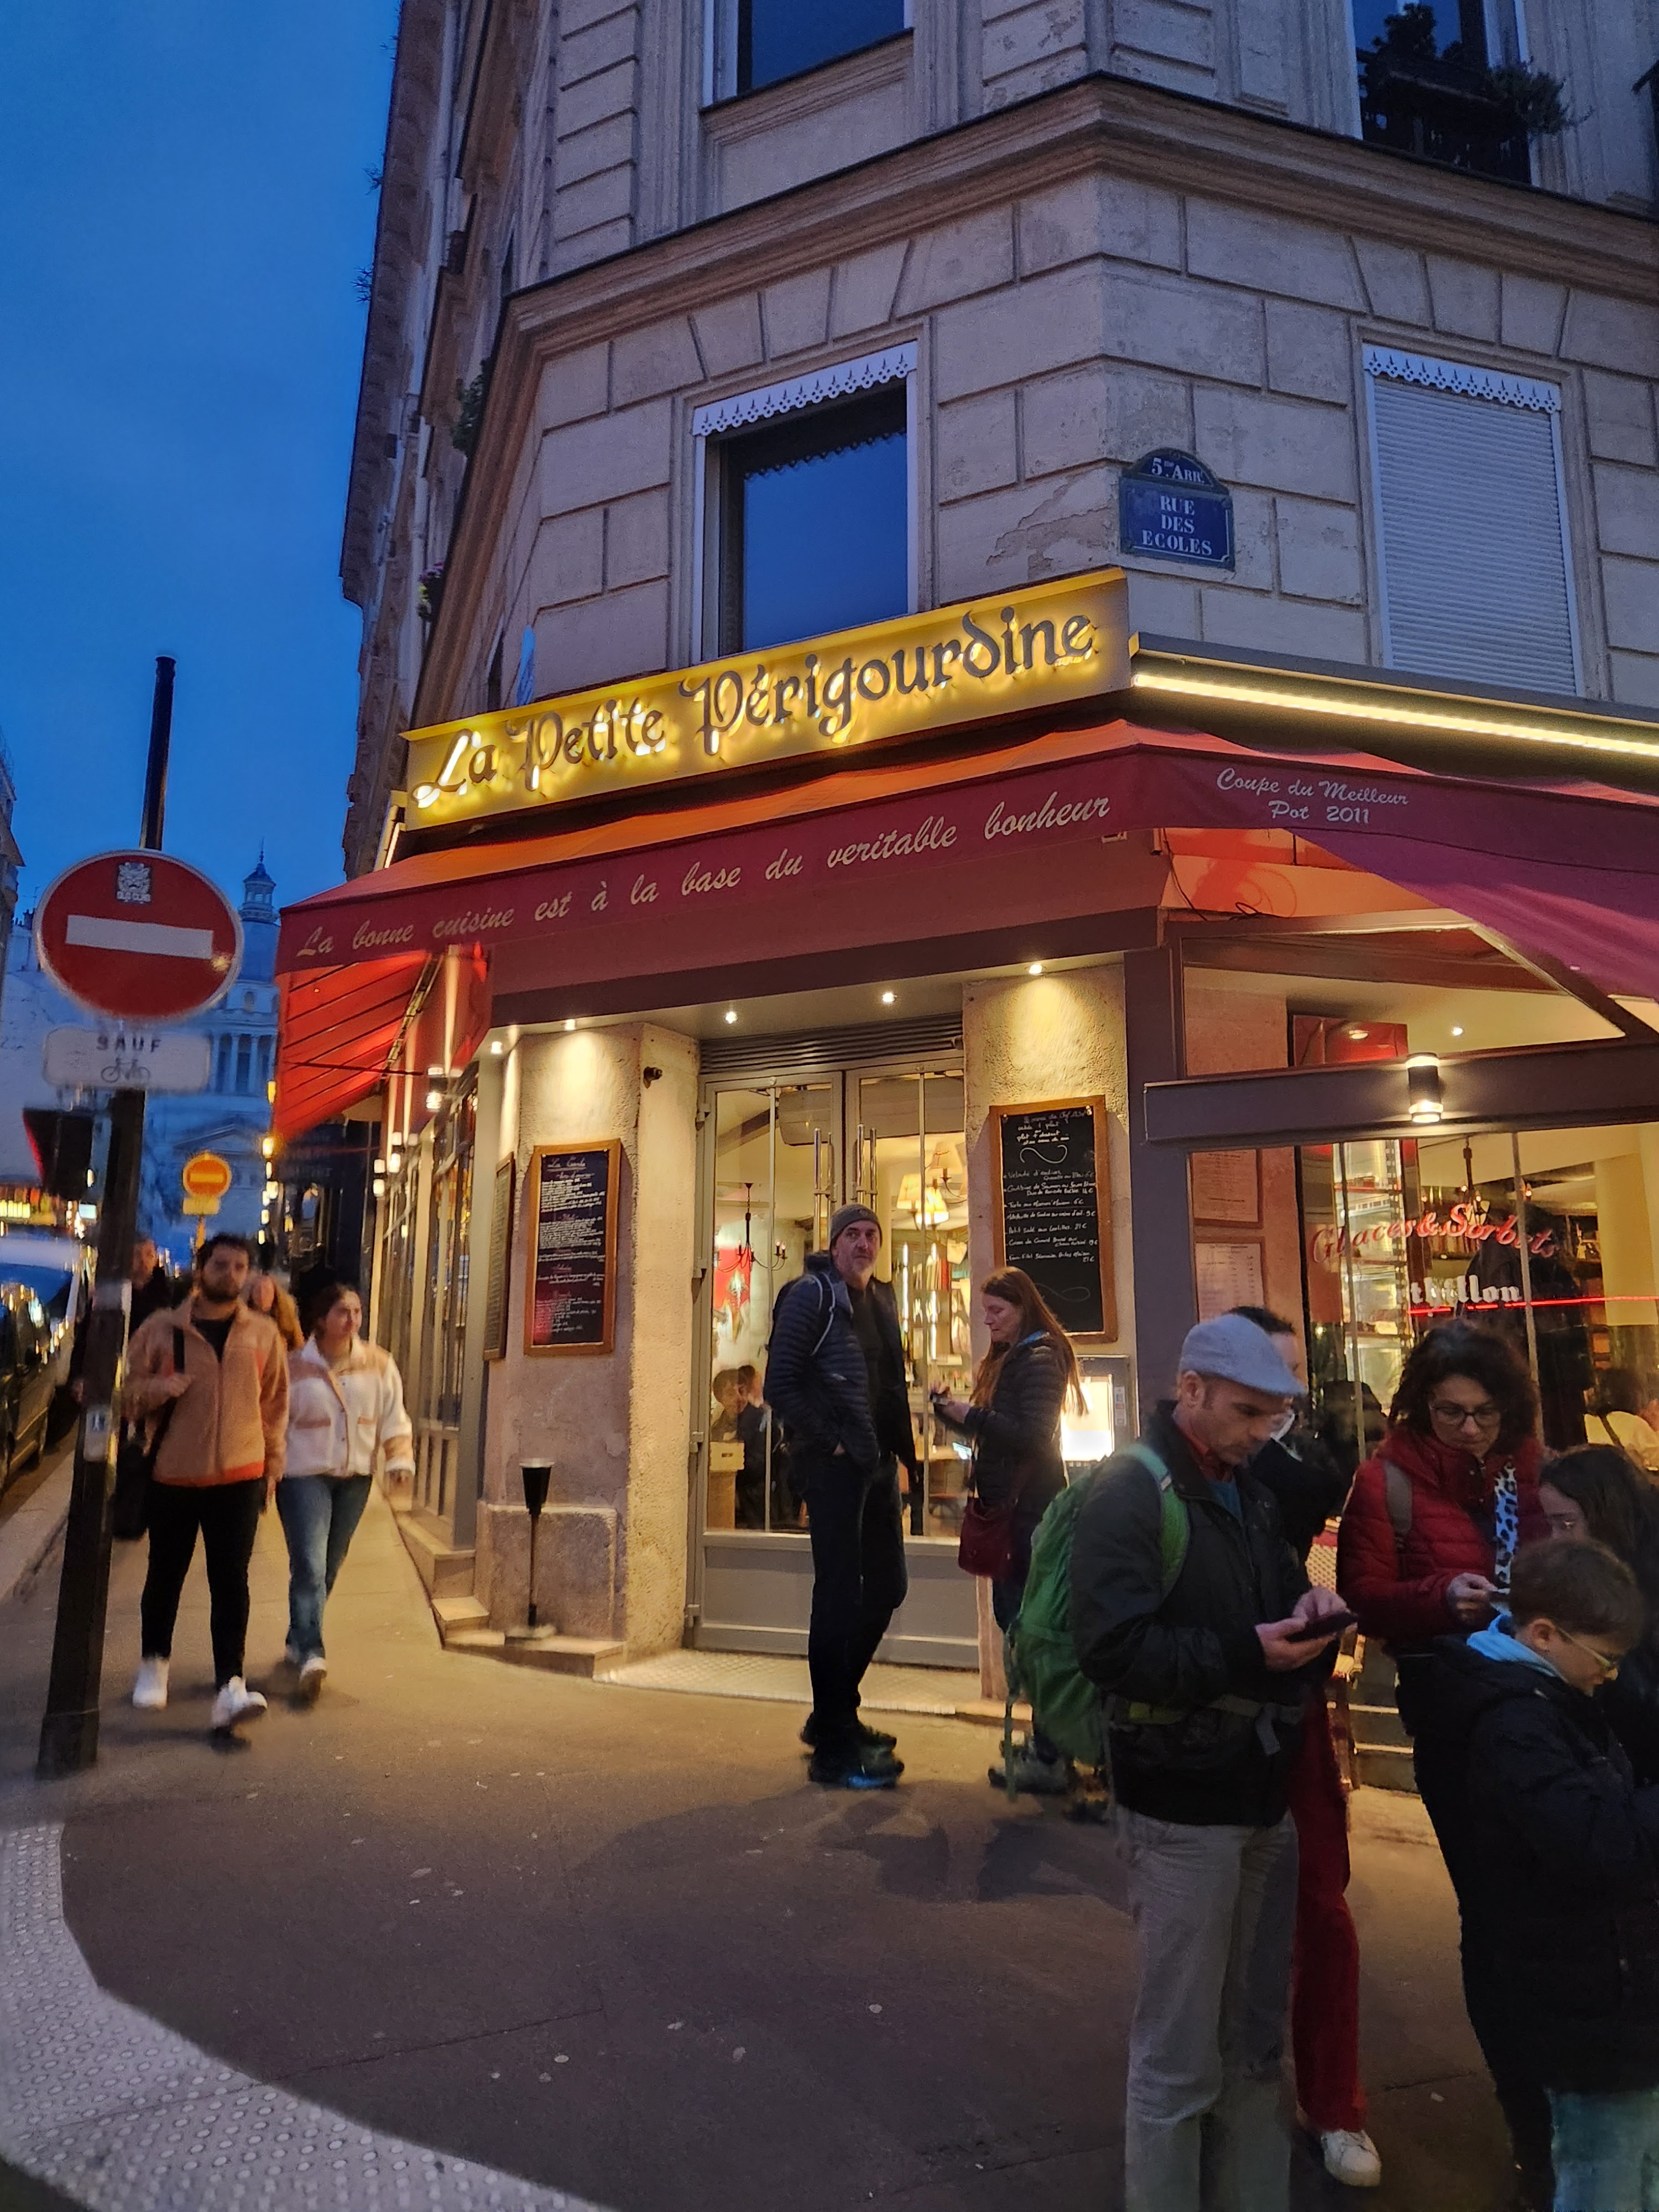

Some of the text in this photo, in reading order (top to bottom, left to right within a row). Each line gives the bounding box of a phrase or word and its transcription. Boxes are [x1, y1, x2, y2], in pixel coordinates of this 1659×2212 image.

[1161, 495, 1194, 515] RUE
[1161, 514, 1195, 534] DES
[1142, 530, 1212, 555] ECOLES
[411, 606, 1095, 802] La Petite Périgourdine
[1217, 768, 1409, 806] Coupe du Meilleur
[1268, 800, 1369, 823] Pot 2011
[296, 791, 1110, 957] La bonne cuisine est à la base du veritable bonheur
[96, 1035, 161, 1053] SAUF
